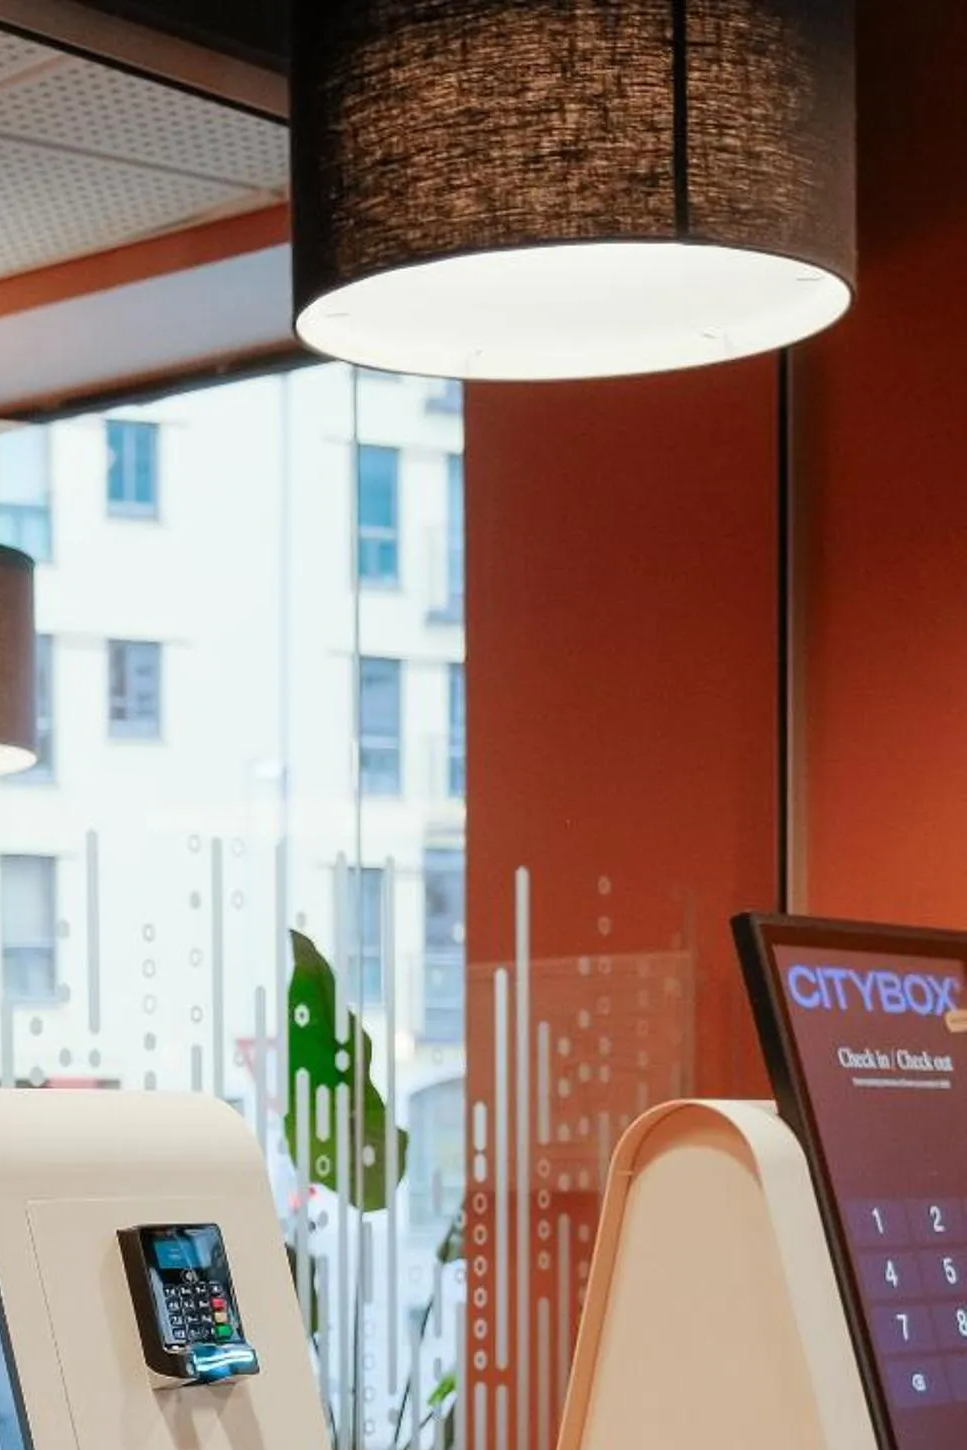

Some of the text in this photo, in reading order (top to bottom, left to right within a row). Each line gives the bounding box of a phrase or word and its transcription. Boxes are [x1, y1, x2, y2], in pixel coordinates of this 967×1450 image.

[837, 1047, 876, 1069] Check
[896, 1050, 933, 1071] Check
[872, 1205, 945, 1234] 1 2
[885, 1257, 957, 1288] 4 5
[896, 1313, 909, 1342] 7
